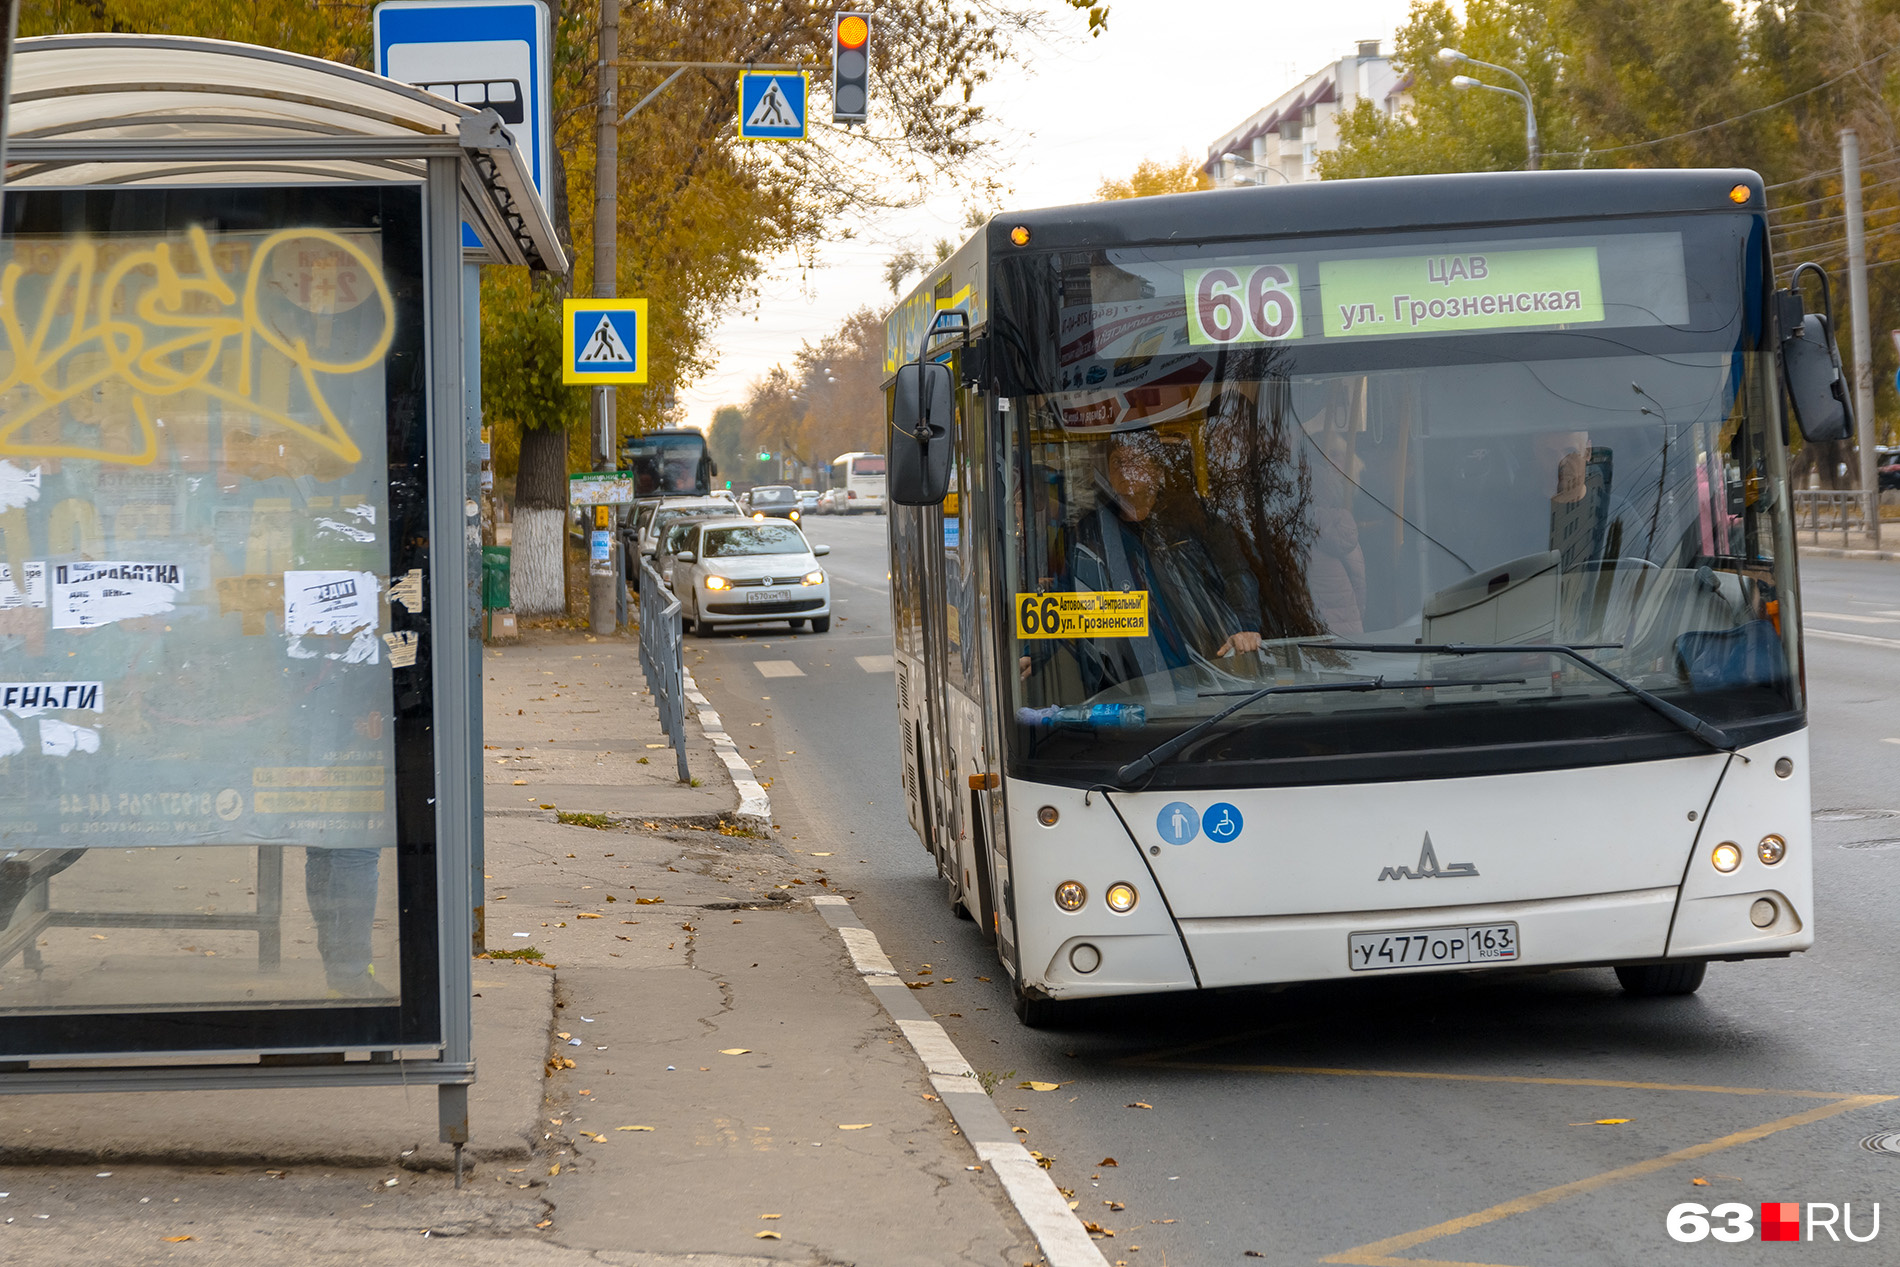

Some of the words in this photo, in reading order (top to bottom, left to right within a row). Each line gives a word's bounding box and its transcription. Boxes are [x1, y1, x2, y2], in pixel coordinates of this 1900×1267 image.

[1426, 255, 1490, 286] ЦАВ
[1194, 264, 1300, 344] 66
[1339, 302, 1385, 331] ул.
[1392, 289, 1582, 327] Грозненская
[1020, 597, 1060, 635] 66
[1060, 597, 1095, 611] Автовокзал
[1060, 616, 1076, 633] ул.
[1078, 615, 1144, 632] Грозненская
[0, 684, 97, 709] ЕНЬГИ
[1470, 928, 1510, 950] 163
[1479, 949, 1500, 958] RUS
